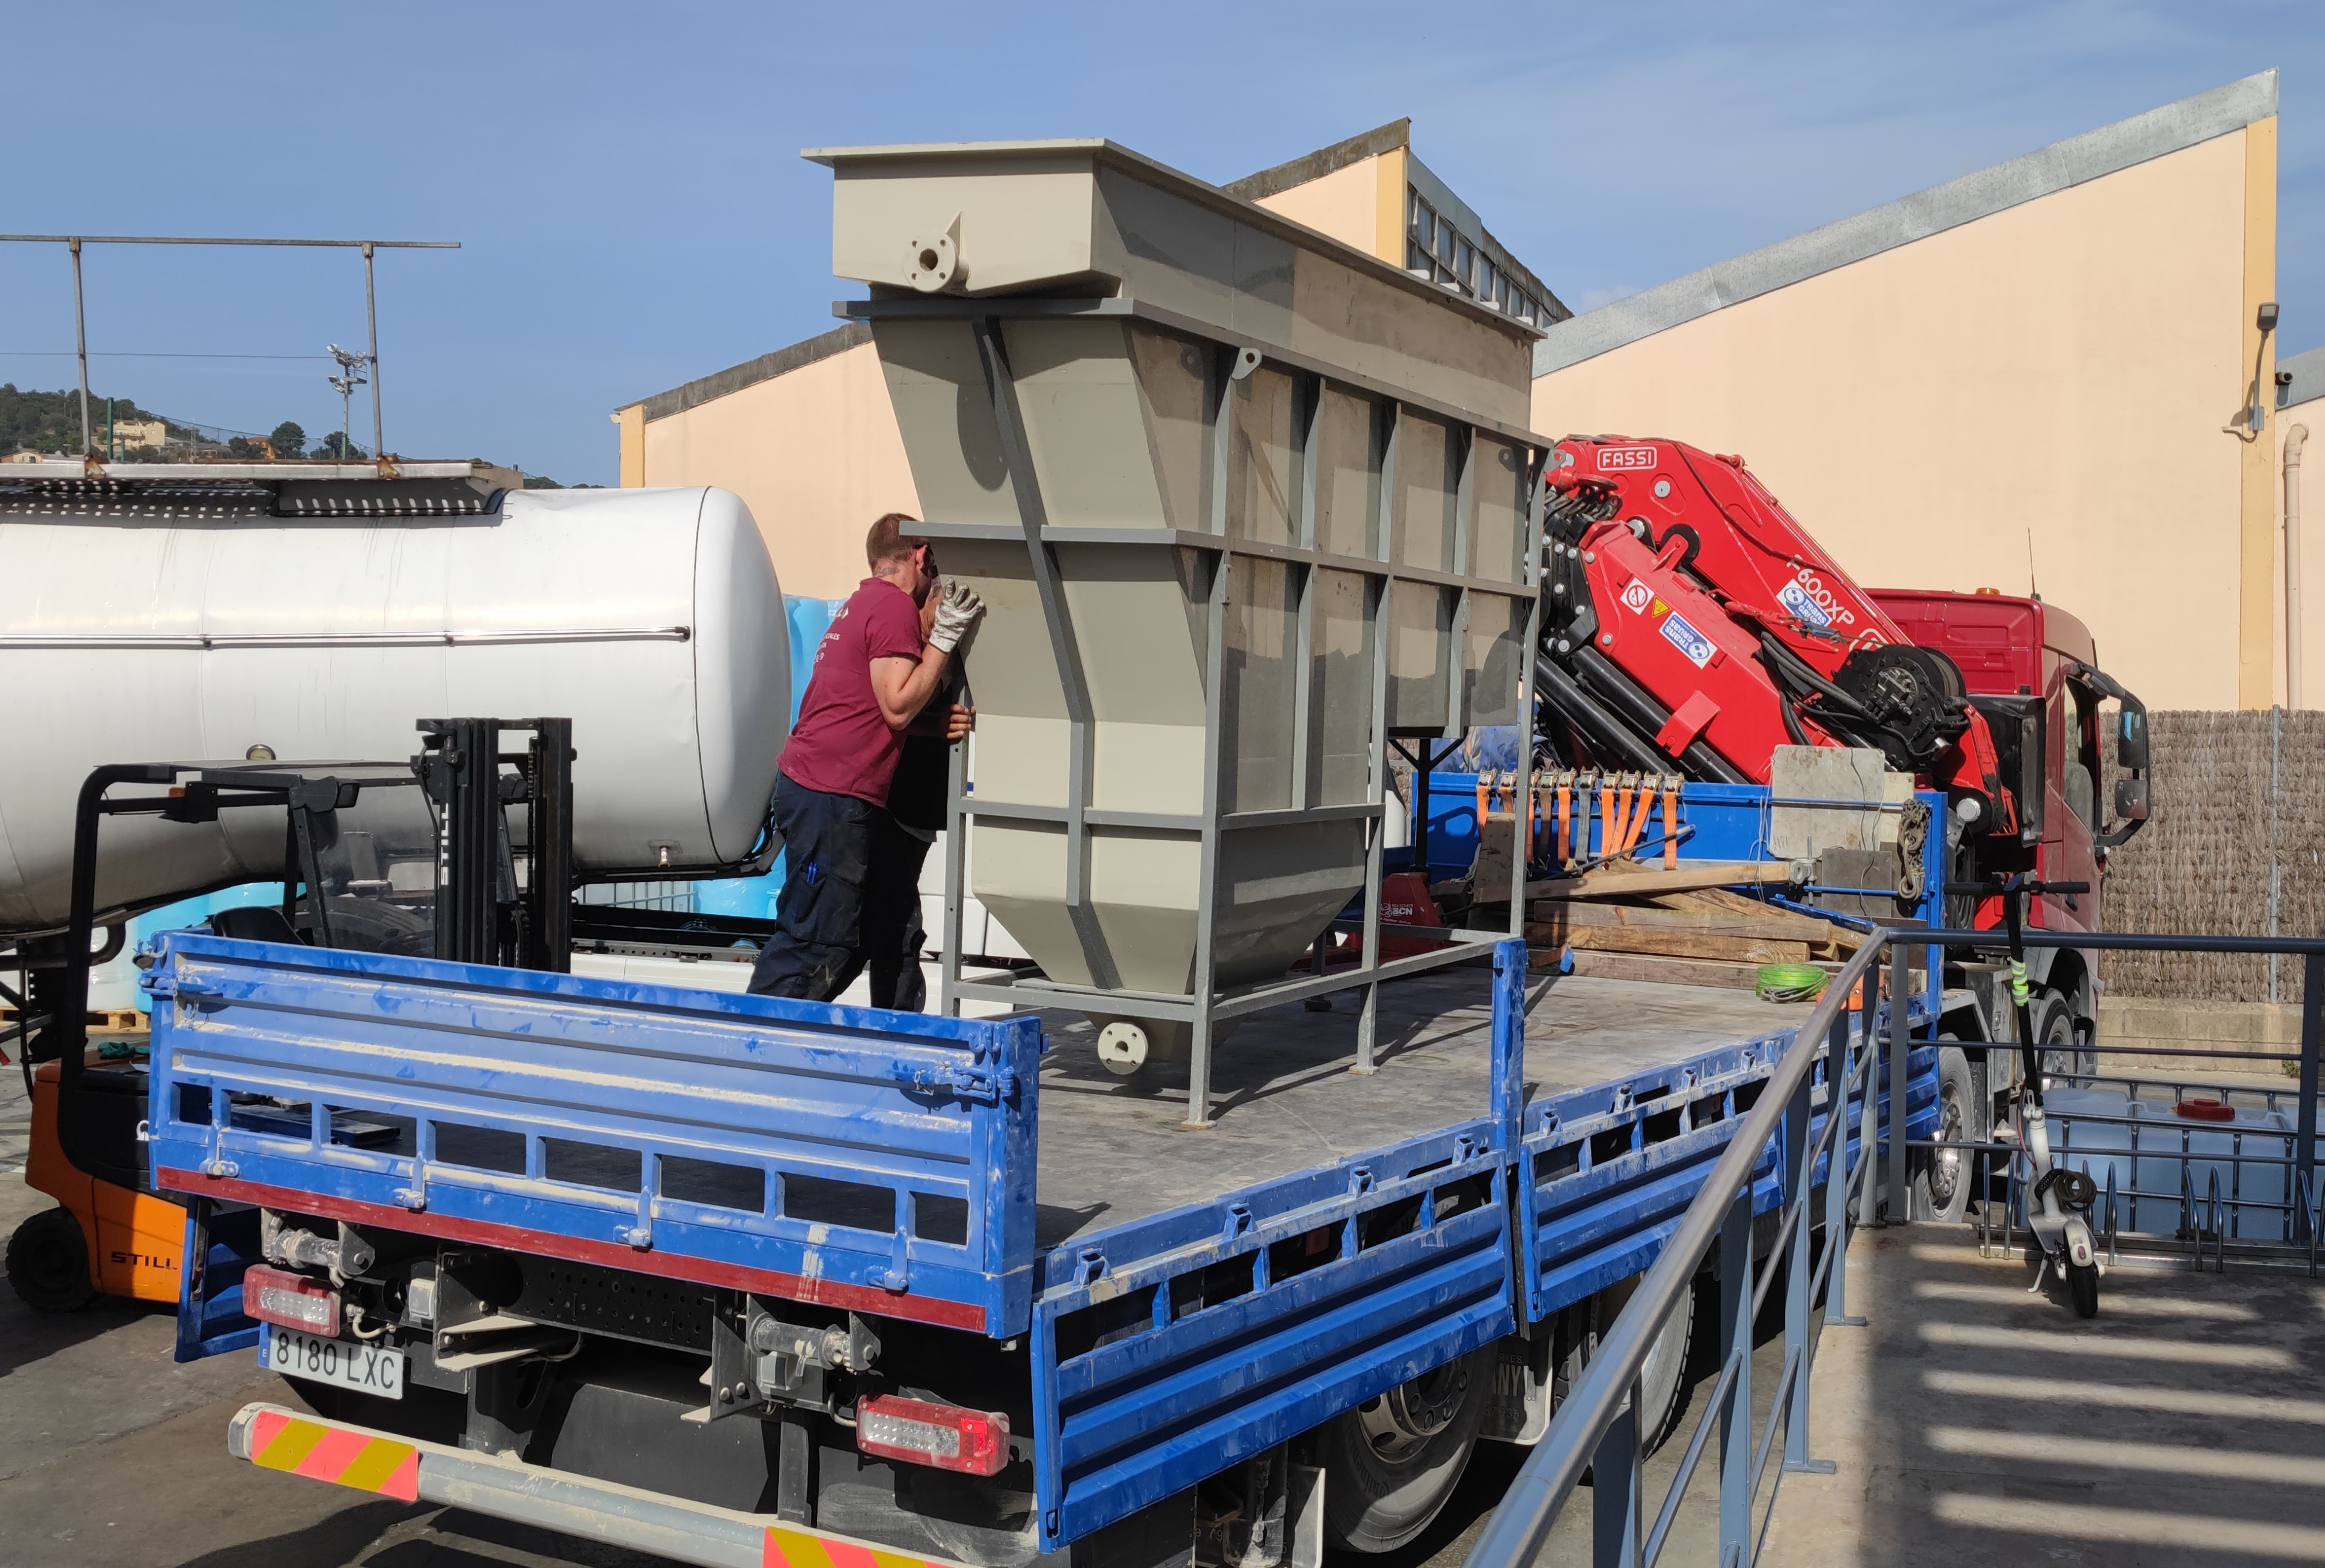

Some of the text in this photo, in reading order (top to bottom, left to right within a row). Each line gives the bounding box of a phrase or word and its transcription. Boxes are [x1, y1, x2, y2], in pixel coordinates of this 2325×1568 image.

[1603, 451, 1651, 467] FASSI
[111, 1251, 178, 1270] STILL
[262, 1349, 268, 1358] E
[276, 1332, 395, 1389] 8180 LXC
